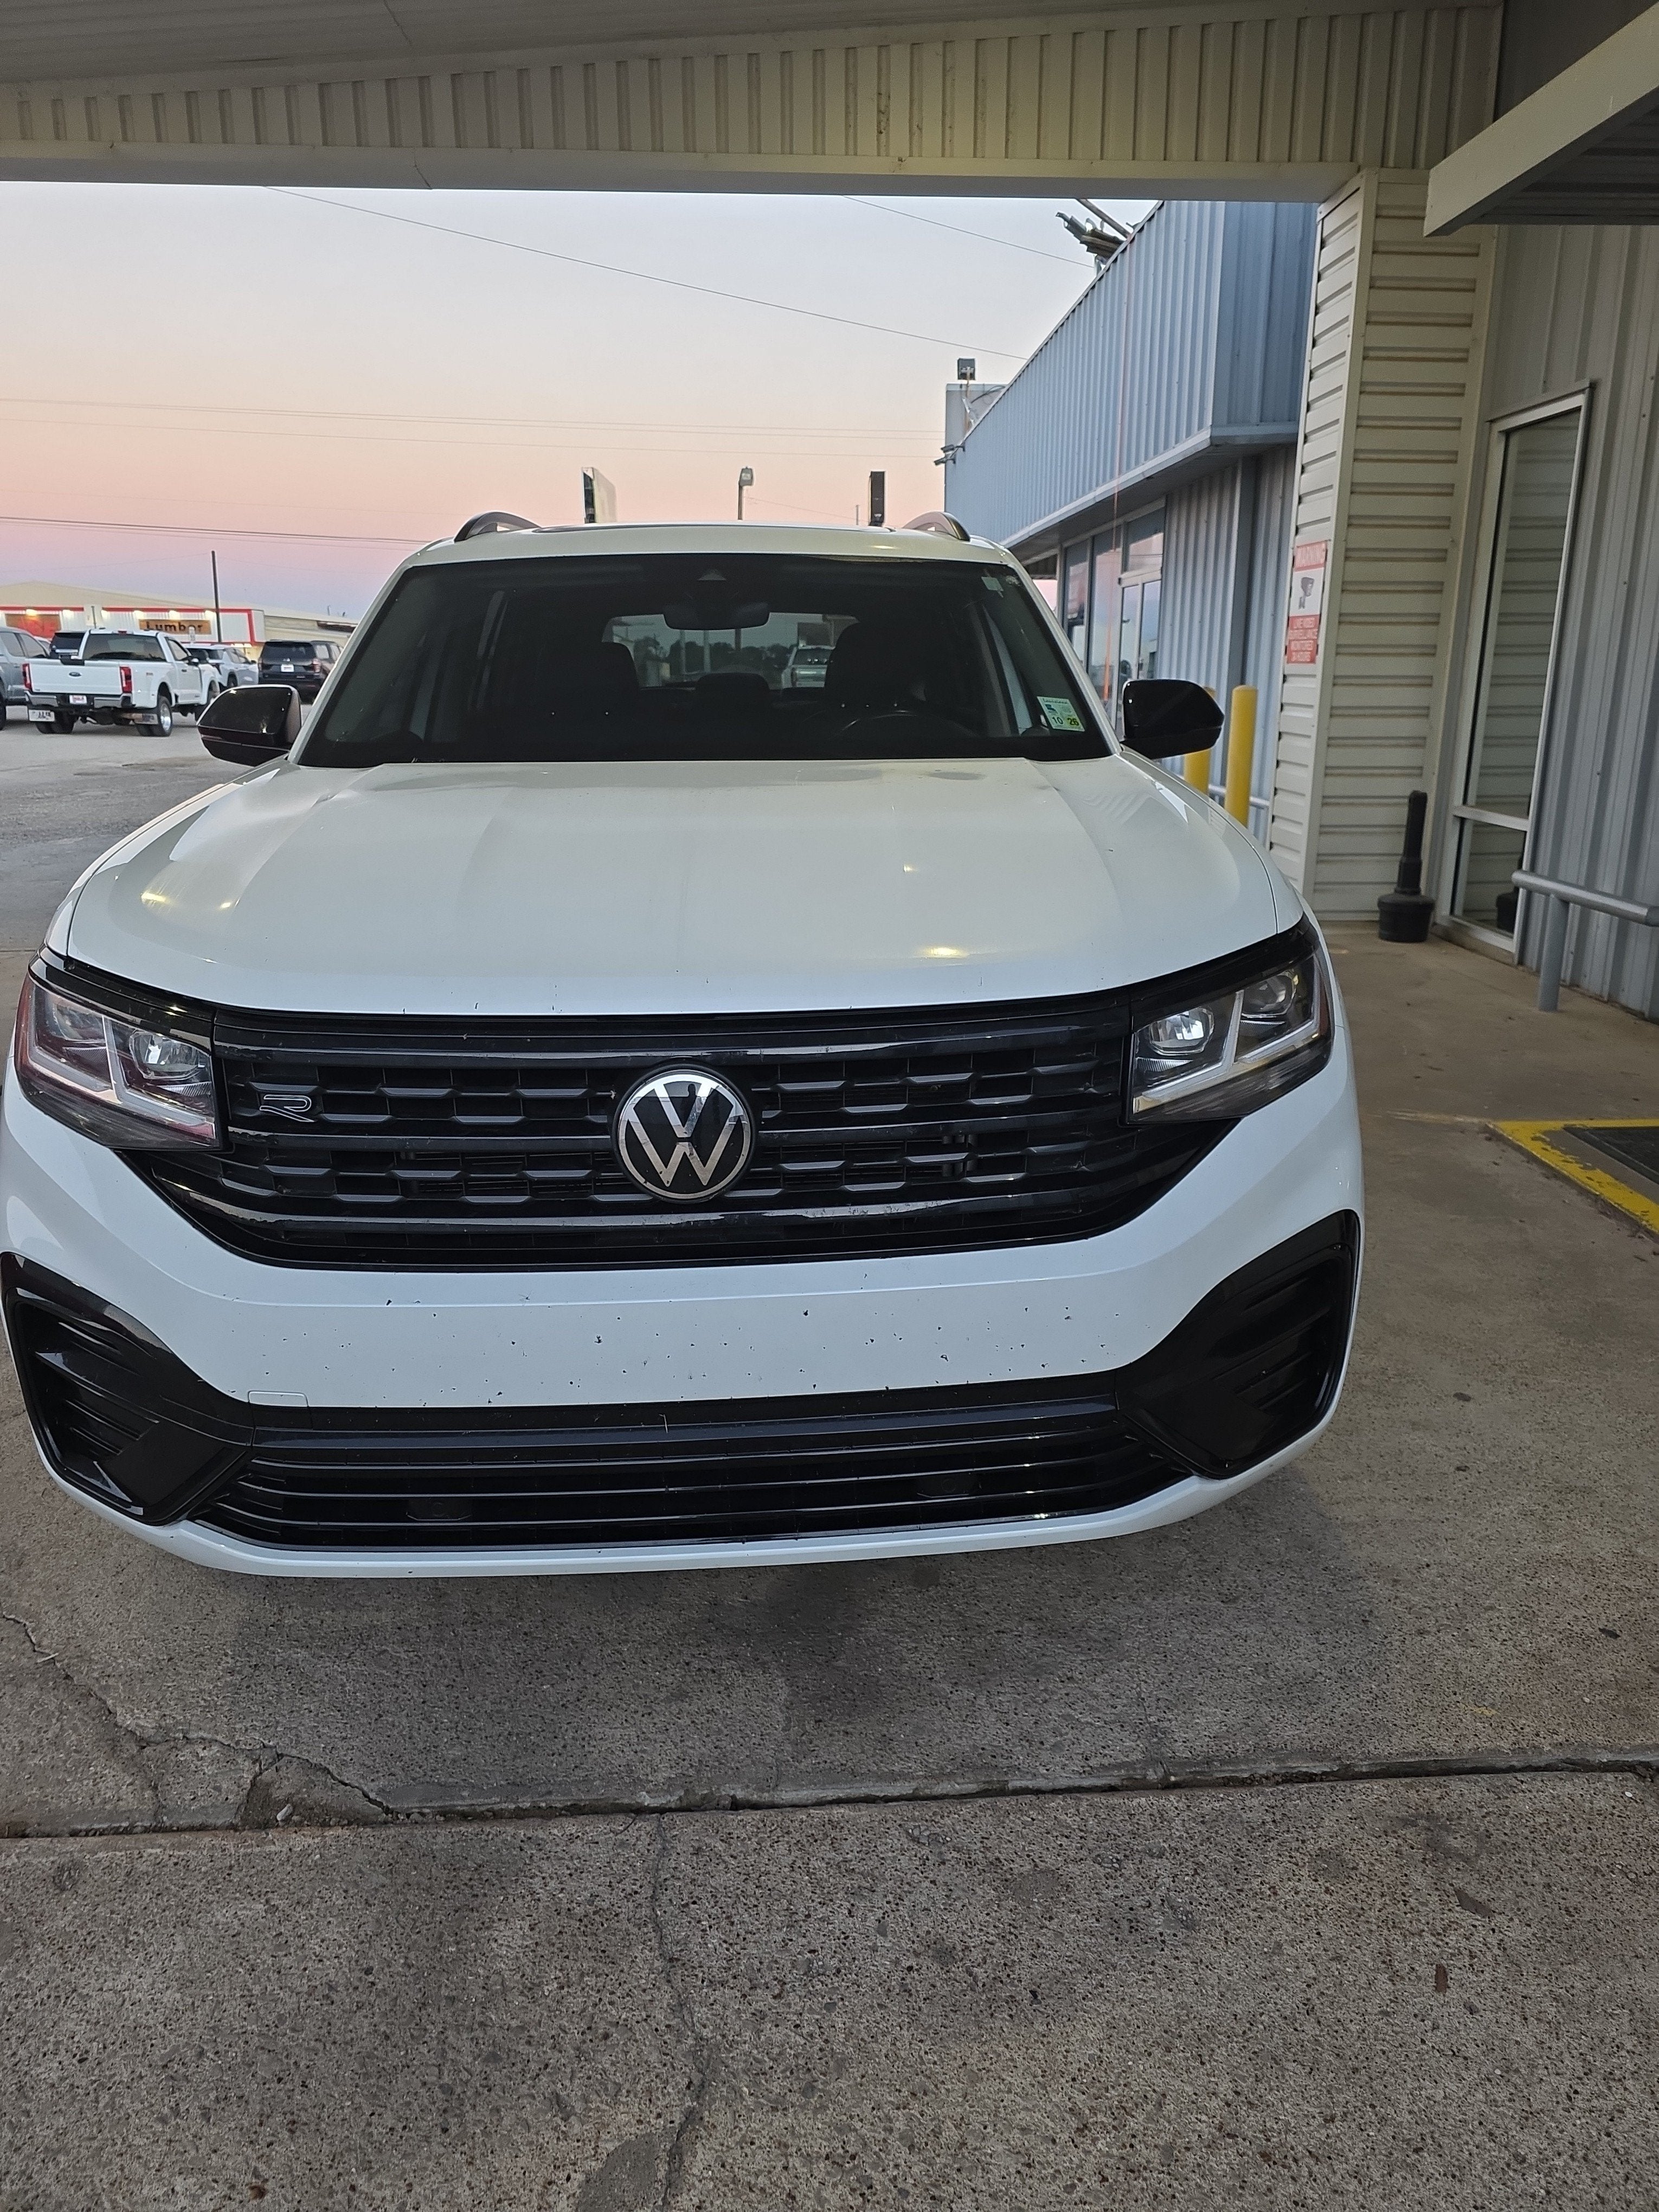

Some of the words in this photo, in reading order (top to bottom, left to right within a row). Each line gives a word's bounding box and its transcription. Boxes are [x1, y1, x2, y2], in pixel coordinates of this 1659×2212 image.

[1052, 716, 1064, 725] 10
[1067, 717, 1079, 726] 26
[259, 1094, 316, 1122] R
